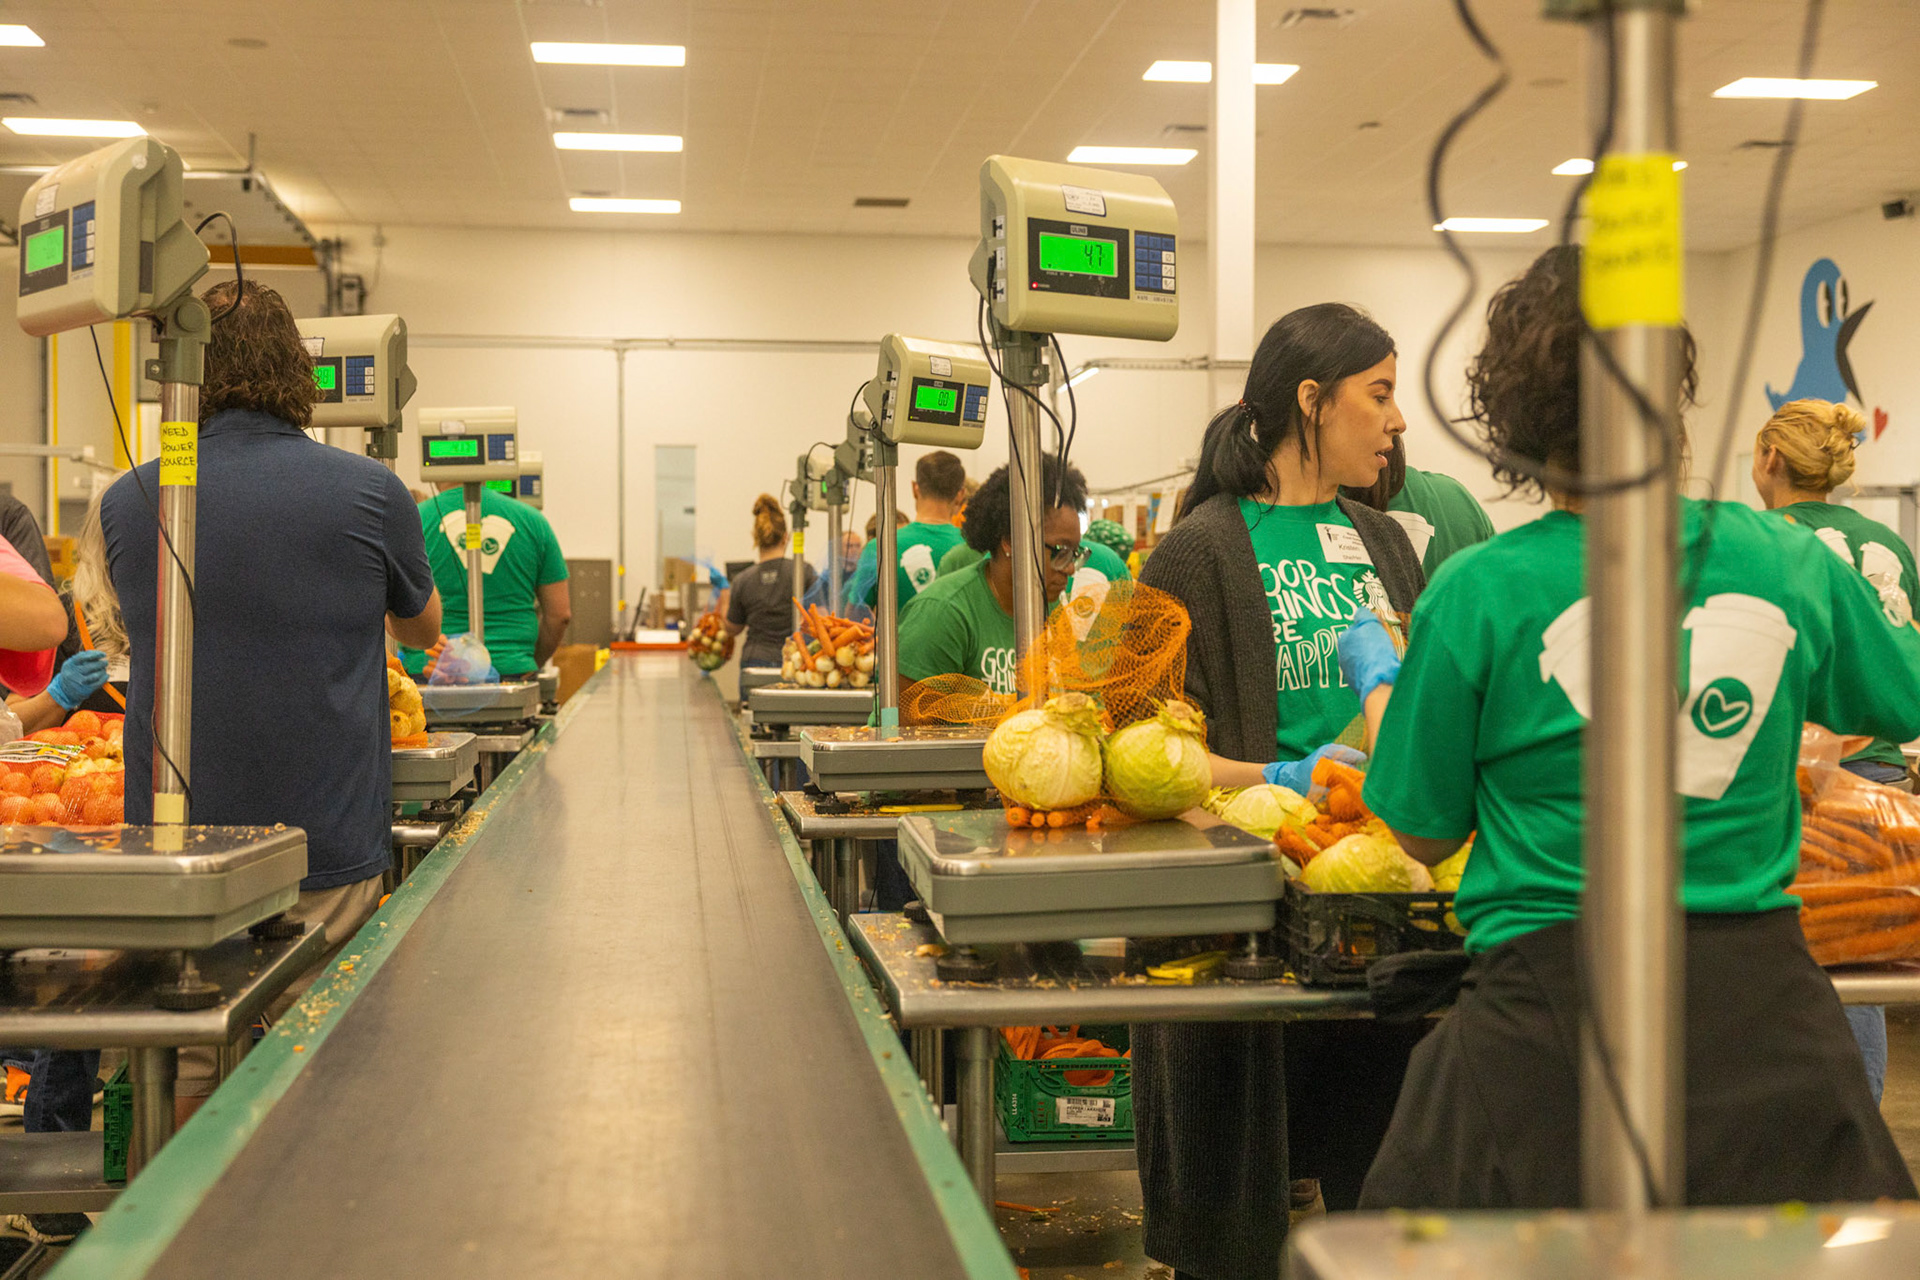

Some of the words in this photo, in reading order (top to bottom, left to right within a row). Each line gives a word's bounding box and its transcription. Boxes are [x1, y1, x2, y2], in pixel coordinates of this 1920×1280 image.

[162, 426, 189, 437] NEED
[162, 441, 195, 452] POWER
[160, 456, 196, 467] SOURCE
[1258, 559, 1317, 597] OOD
[1271, 573, 1358, 621] HINGS
[1271, 620, 1303, 643] RE
[981, 646, 1017, 680] GOO
[981, 669, 1017, 693] THIN
